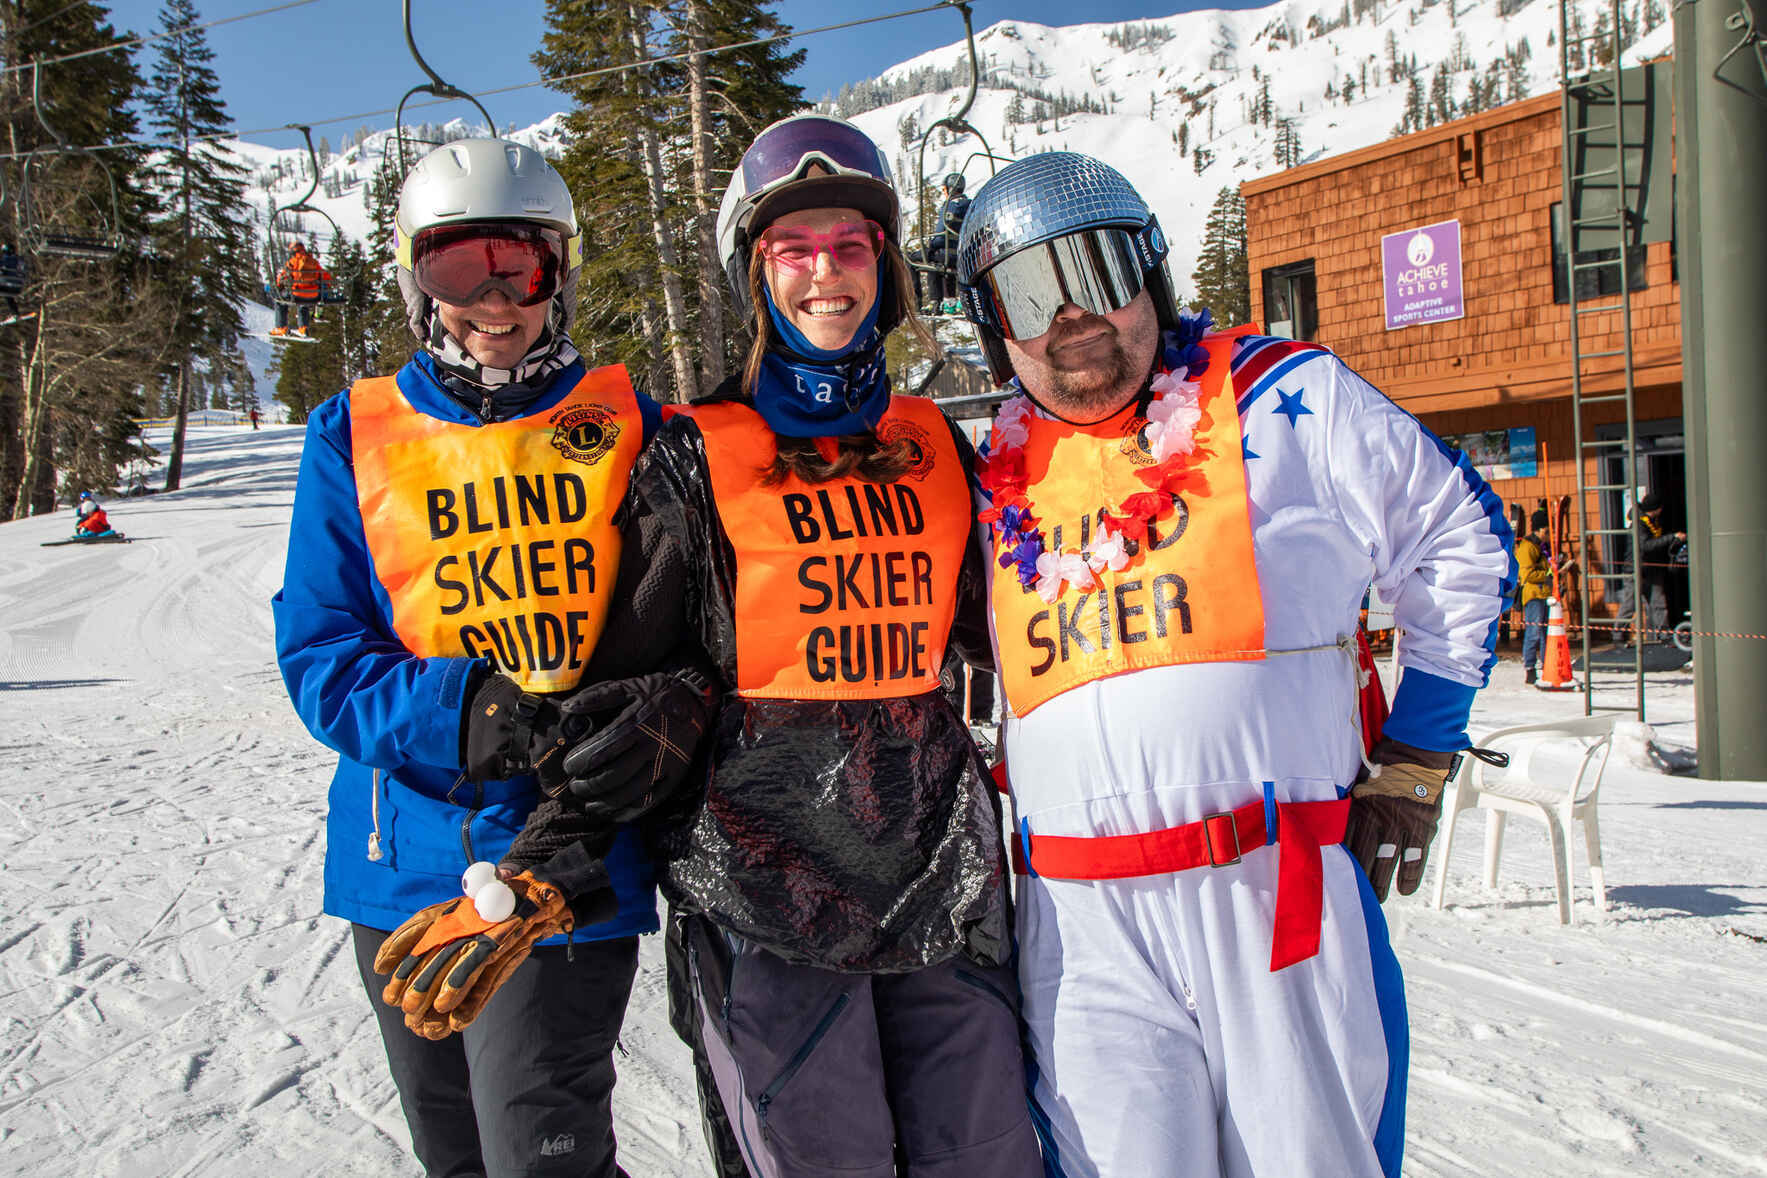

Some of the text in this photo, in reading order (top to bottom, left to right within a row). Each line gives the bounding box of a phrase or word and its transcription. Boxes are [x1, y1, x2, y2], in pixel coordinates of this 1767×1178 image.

[1397, 263, 1448, 285] ACHIEVE
[1398, 279, 1448, 297] tahoe
[1404, 297, 1443, 311] ADAPTIVE
[1393, 305, 1456, 323] SPORTS CENTER
[426, 472, 588, 542] BLIND
[782, 484, 925, 544] BLIND
[434, 538, 595, 616] SKIER
[797, 551, 933, 614] SKIER
[459, 611, 588, 673] GUIDE
[806, 621, 929, 684] GUIDE
[1026, 573, 1193, 677] SKIER
